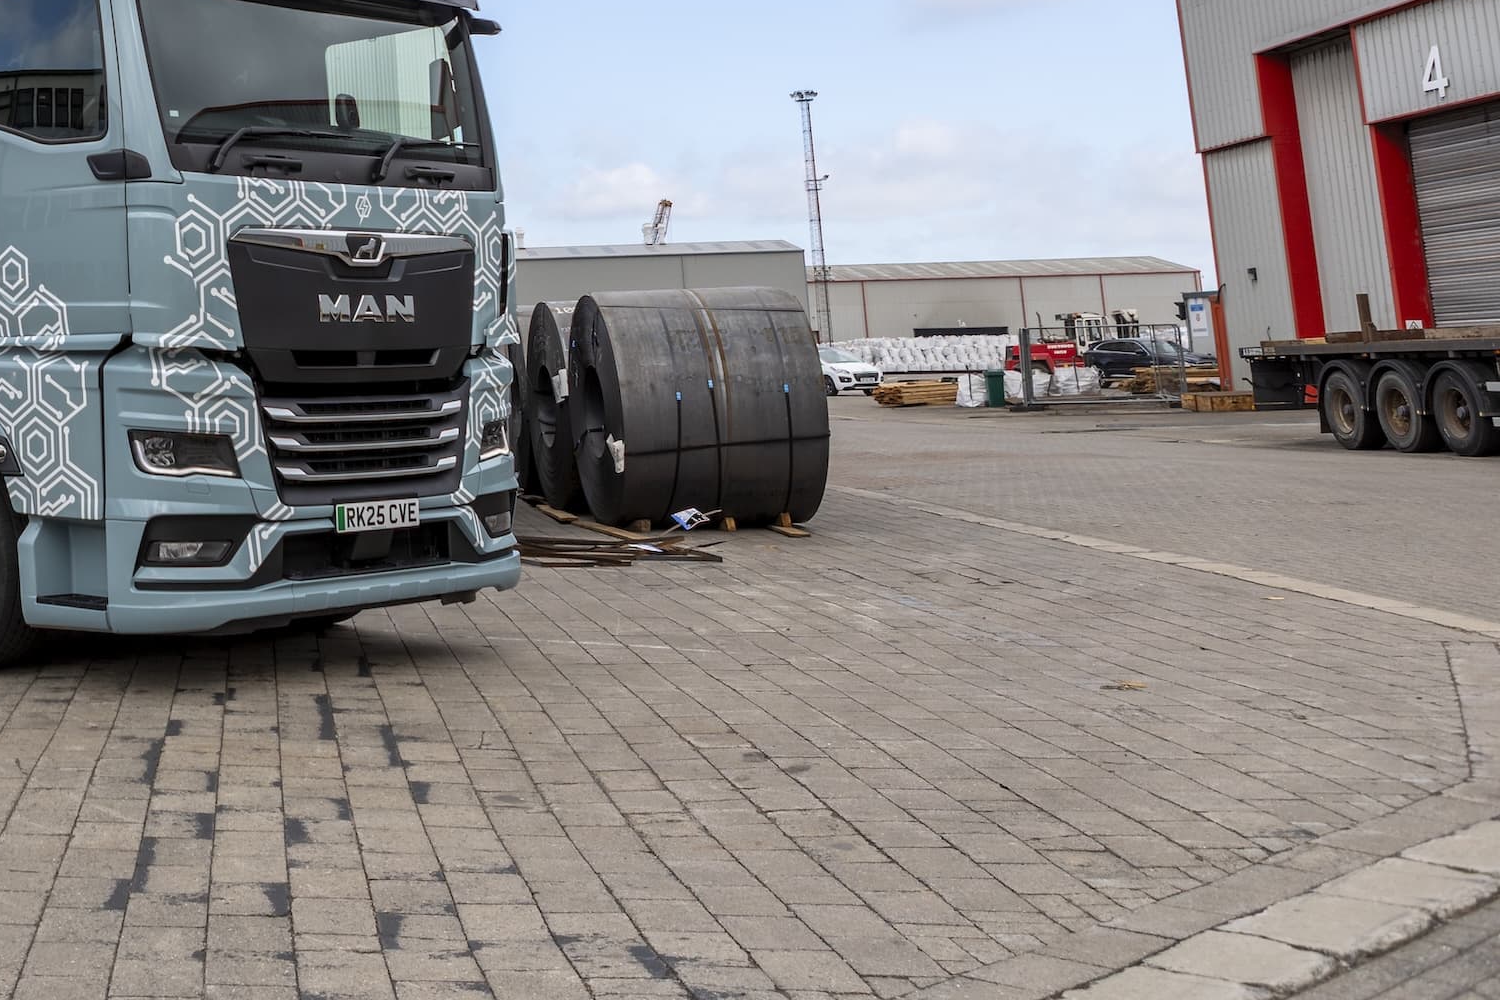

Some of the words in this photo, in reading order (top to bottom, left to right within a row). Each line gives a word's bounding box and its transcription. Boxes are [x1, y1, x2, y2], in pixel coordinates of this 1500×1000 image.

[1422, 44, 1450, 99] 4
[318, 293, 416, 323] MAN
[346, 505, 385, 528] RK25
[389, 502, 417, 524] CVE
